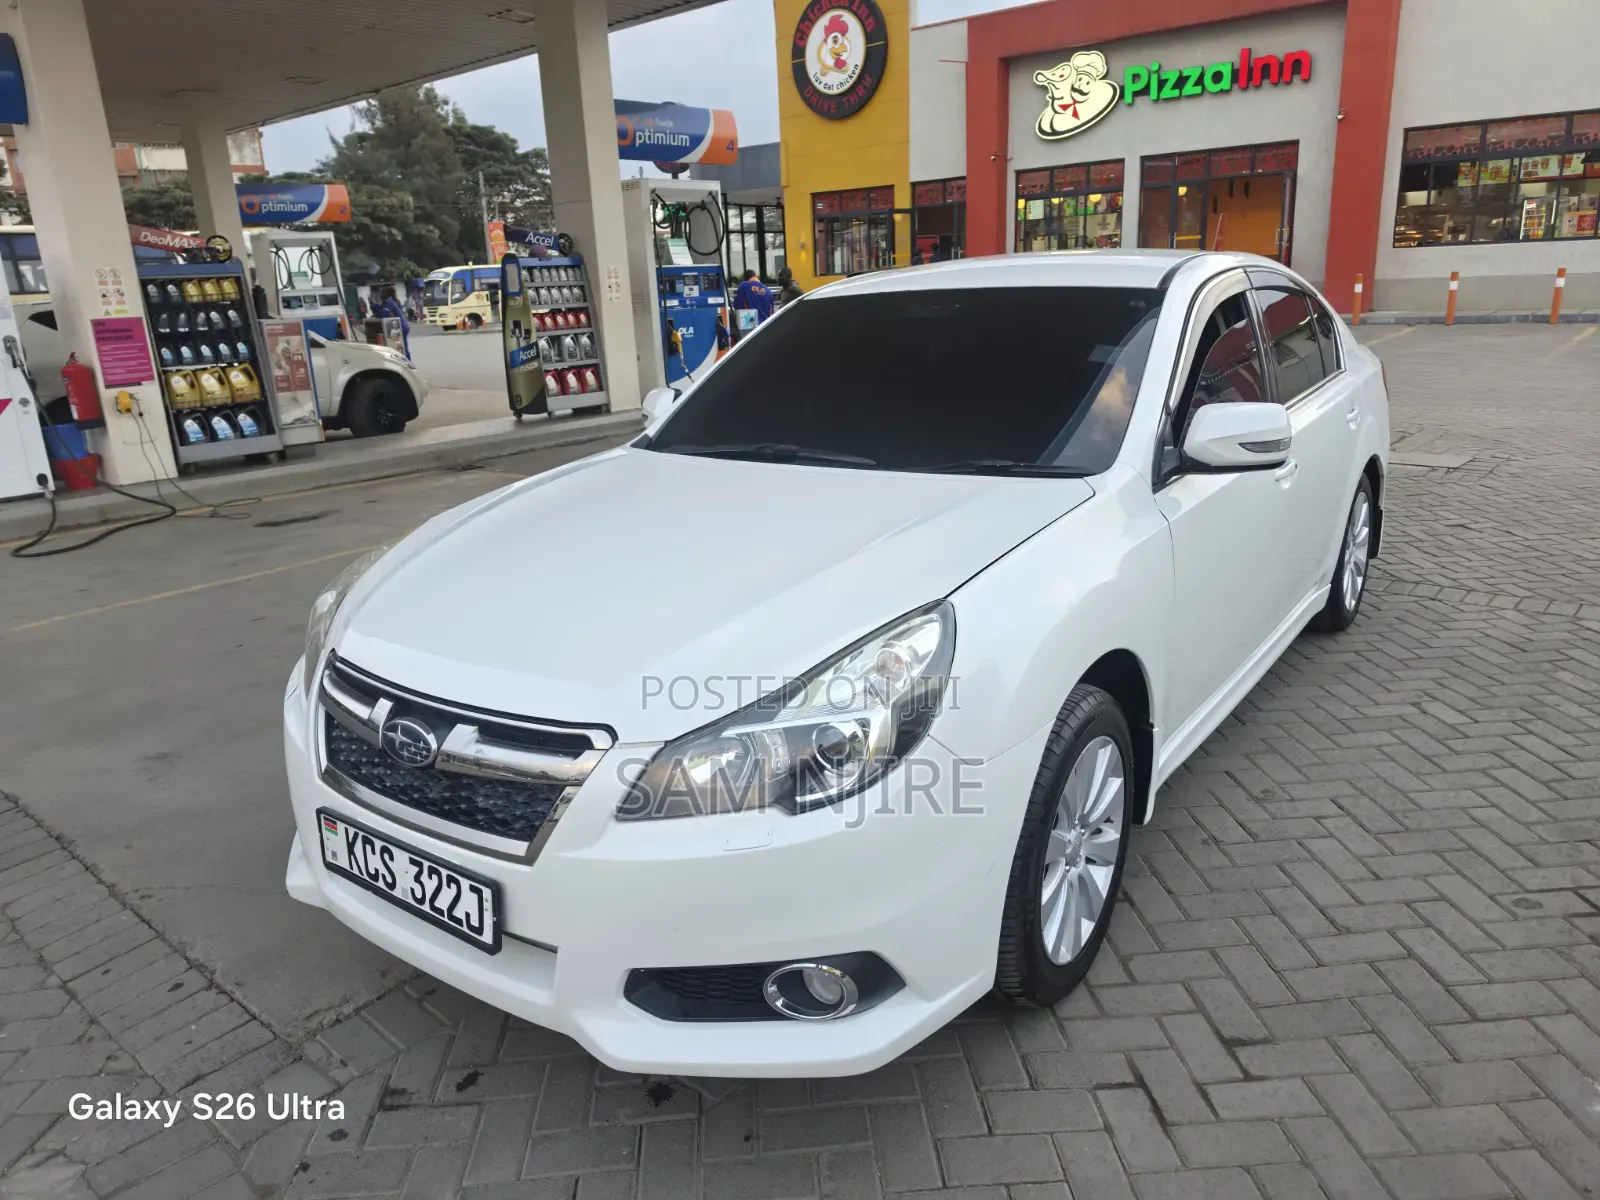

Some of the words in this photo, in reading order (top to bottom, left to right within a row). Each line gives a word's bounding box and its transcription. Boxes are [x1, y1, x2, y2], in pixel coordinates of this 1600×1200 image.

[851, 0, 876, 33] Inn
[812, 72, 822, 86] luv
[823, 82, 834, 91] dat
[836, 63, 859, 90] chicken
[803, 86, 837, 113] DRIVE
[841, 74, 873, 109] THRU
[615, 115, 690, 147] Optimium
[726, 139, 735, 152] 4
[241, 194, 308, 215] Optimium
[339, 205, 347, 214] 2
[525, 231, 554, 247] Accel
[751, 285, 766, 295] OLA
[520, 346, 537, 361] Accel
[344, 826, 397, 892] KCS
[408, 856, 485, 937] 322J
